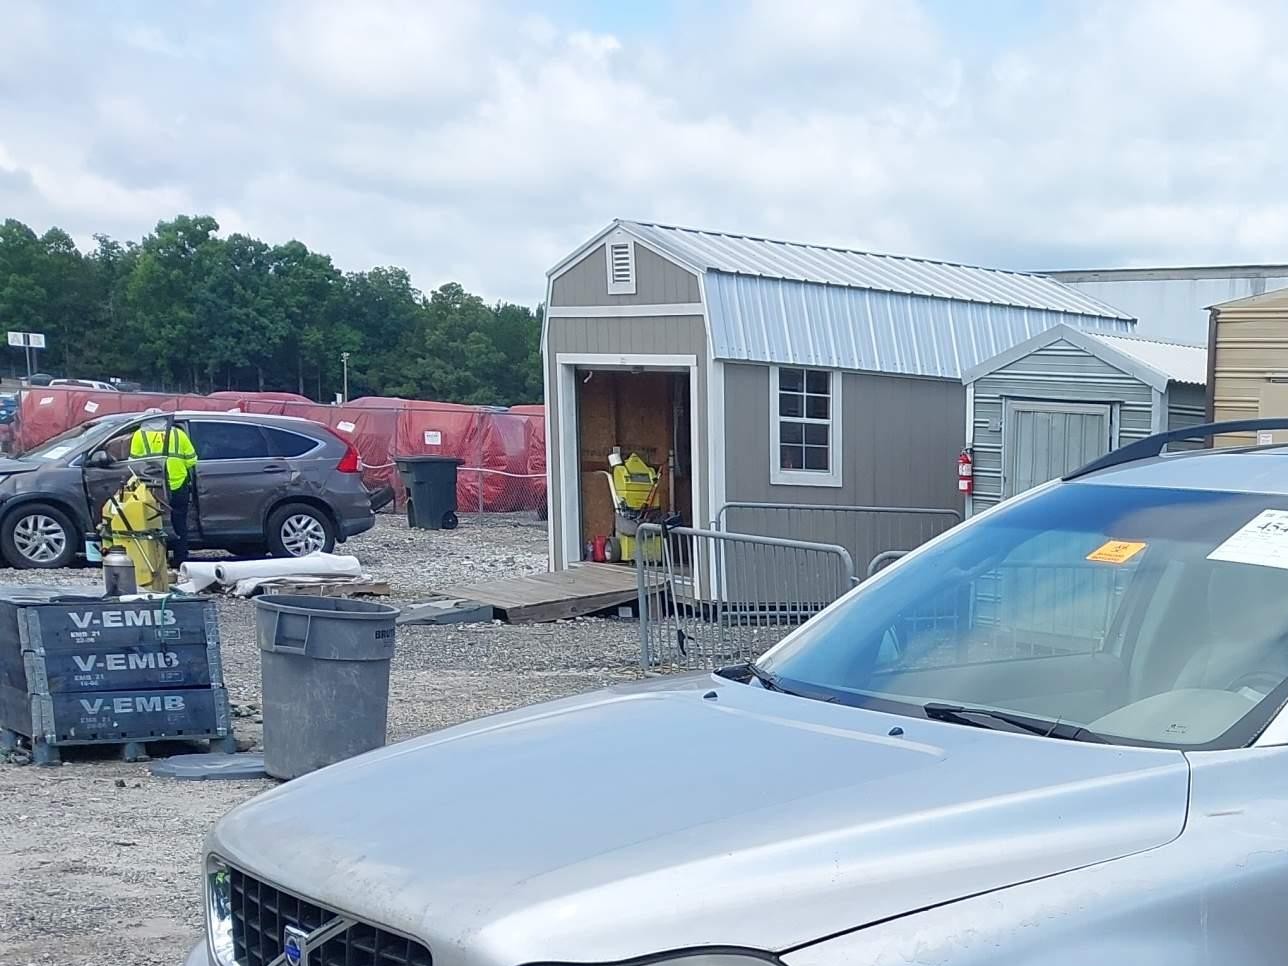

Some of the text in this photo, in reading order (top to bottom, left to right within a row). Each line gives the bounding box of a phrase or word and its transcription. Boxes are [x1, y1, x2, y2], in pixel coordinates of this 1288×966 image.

[67, 609, 177, 629] V-EMB
[72, 652, 180, 672] V-EMB
[80, 695, 185, 715] V-EMB
